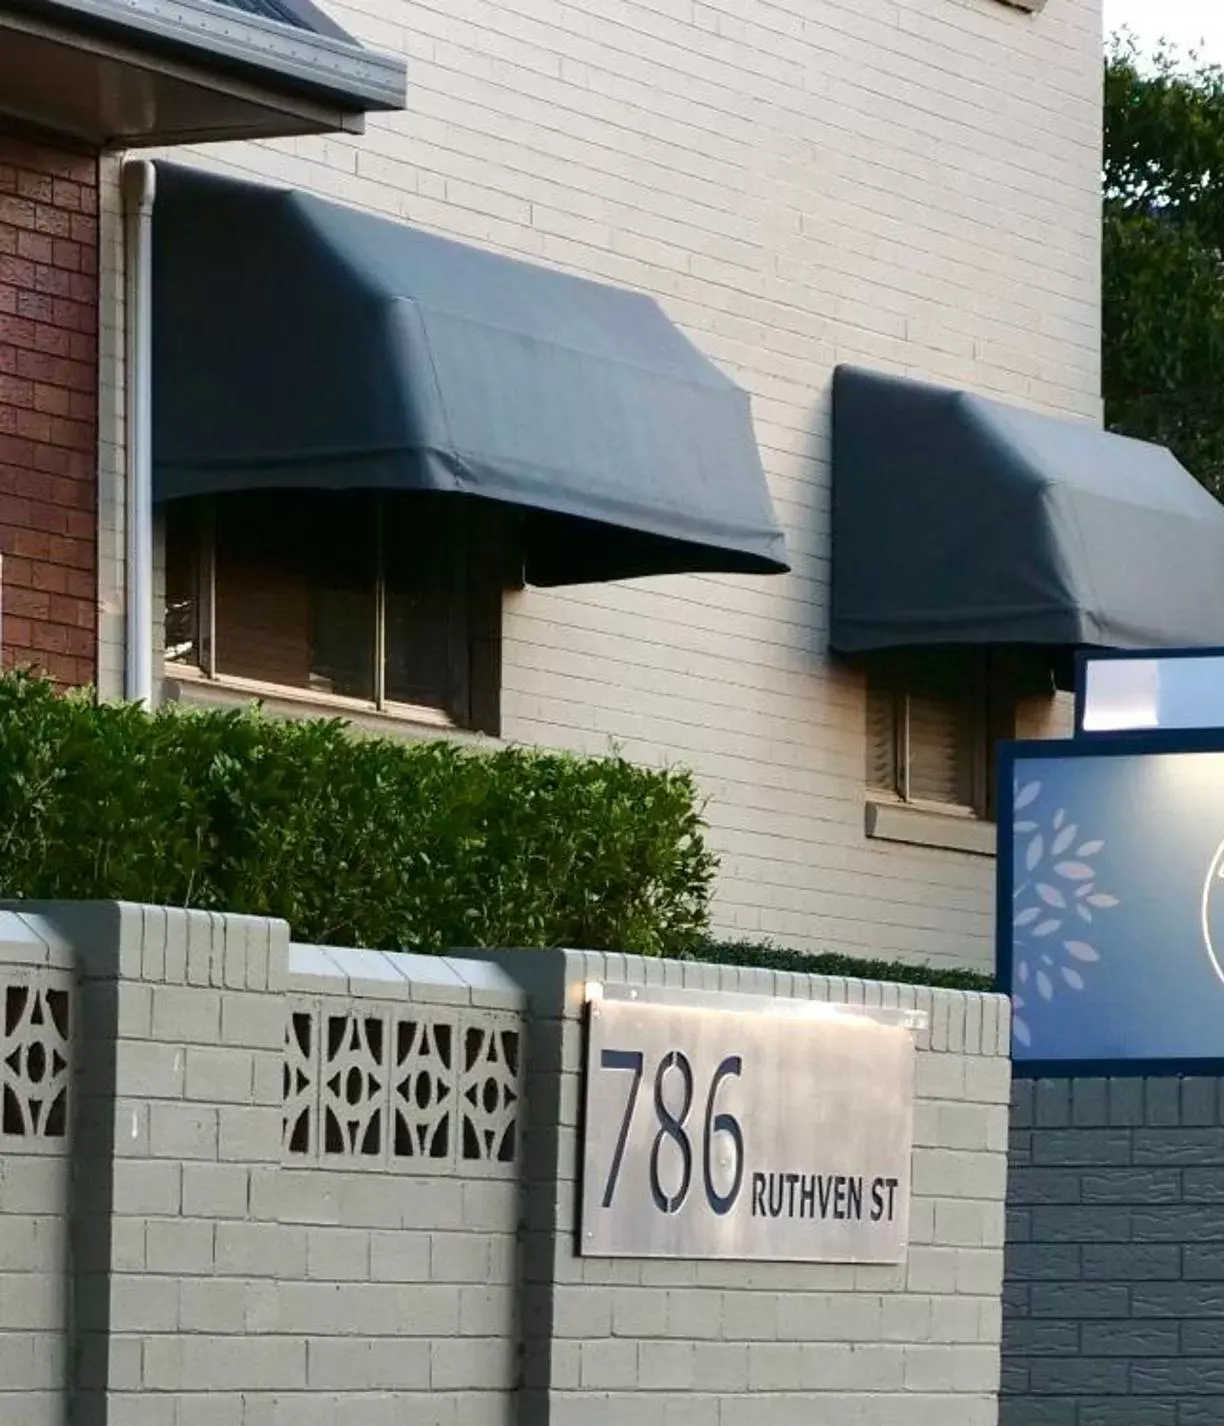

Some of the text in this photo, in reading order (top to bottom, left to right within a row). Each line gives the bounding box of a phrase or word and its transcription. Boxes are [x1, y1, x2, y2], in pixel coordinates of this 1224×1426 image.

[600, 1048, 898, 1221] 786 RUTHVEN ST
